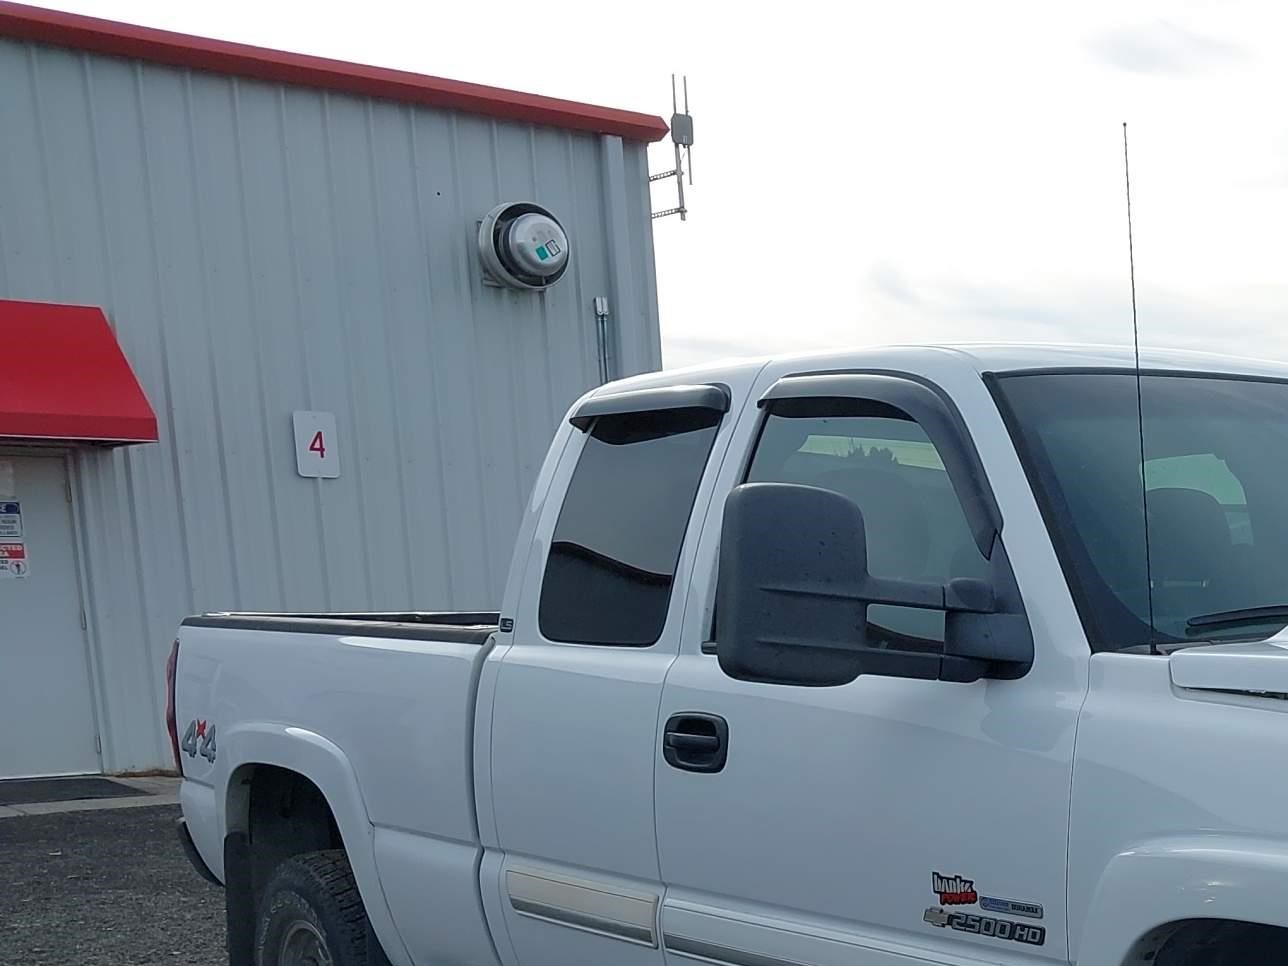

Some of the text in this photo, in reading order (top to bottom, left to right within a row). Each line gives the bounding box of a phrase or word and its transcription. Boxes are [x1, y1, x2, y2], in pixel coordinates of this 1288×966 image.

[309, 431, 326, 458] 4
[951, 913, 1041, 943] 2500 HD
